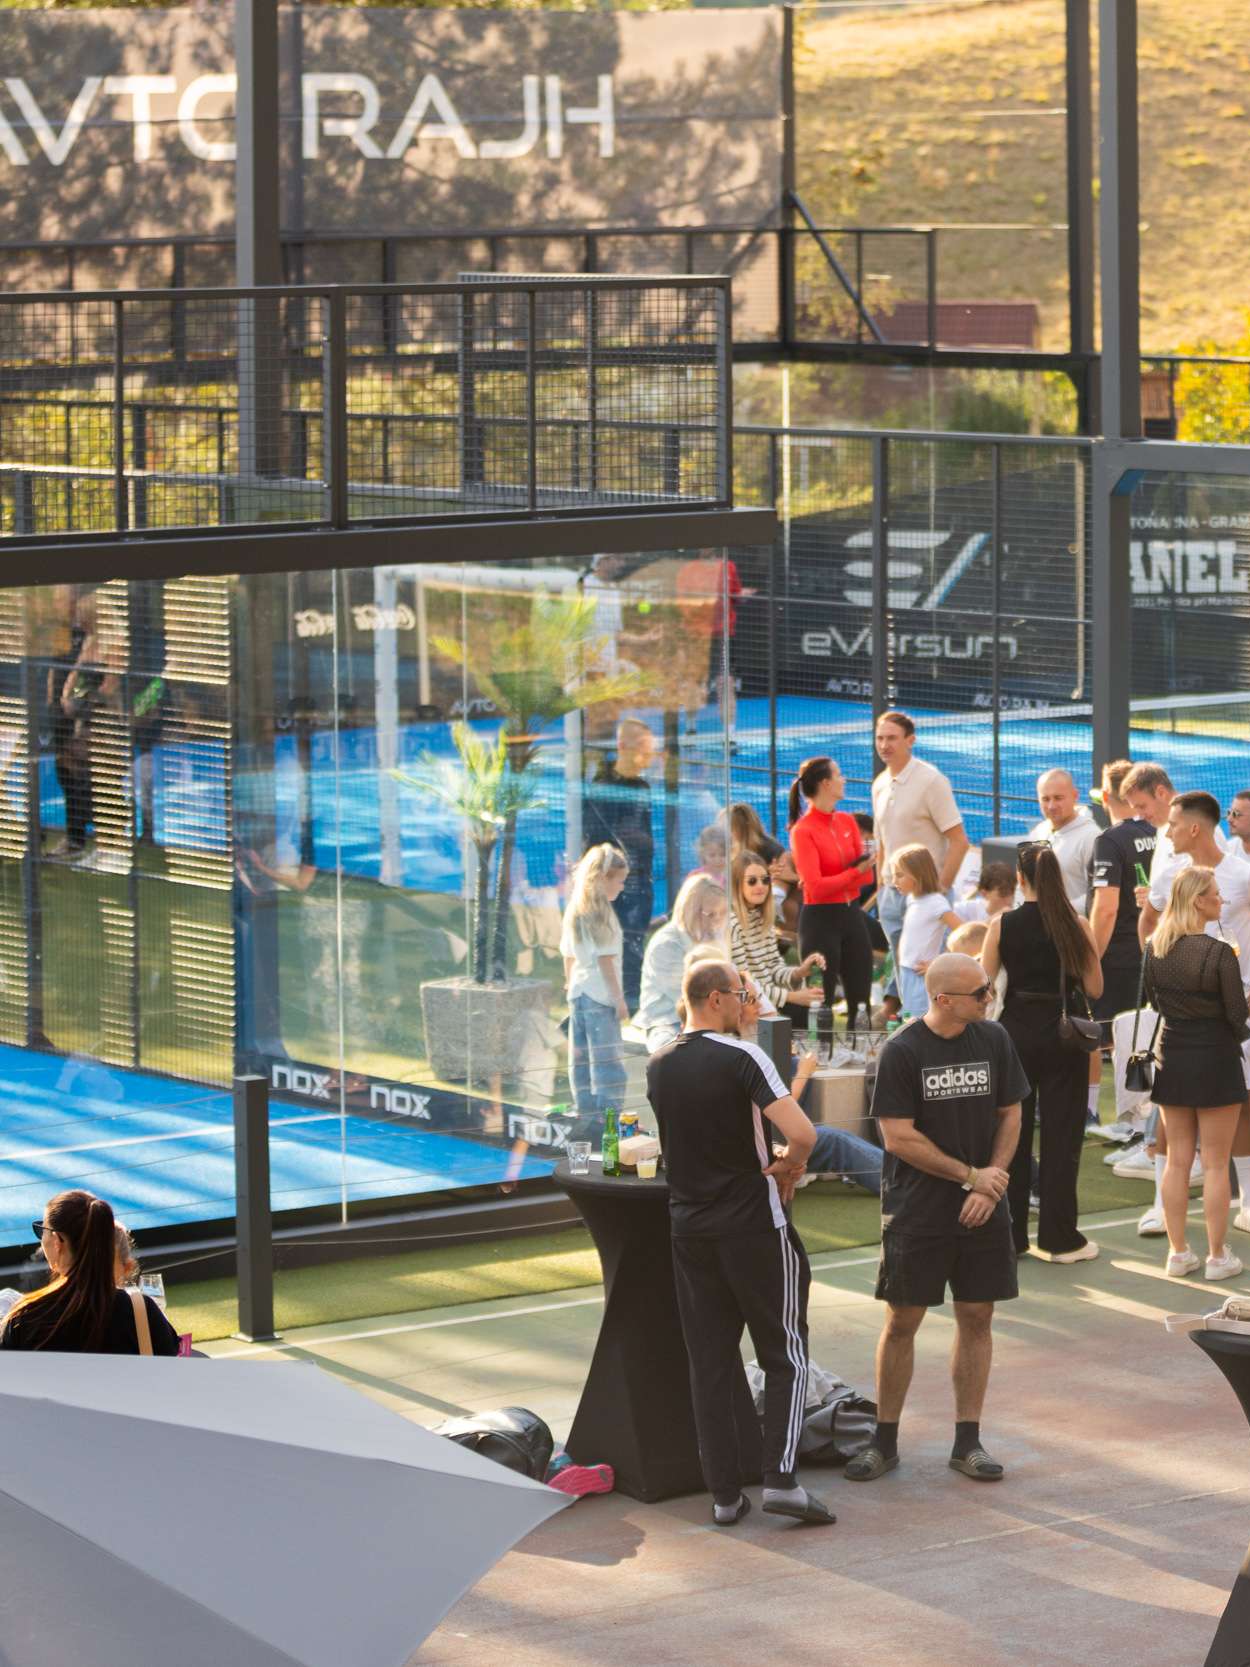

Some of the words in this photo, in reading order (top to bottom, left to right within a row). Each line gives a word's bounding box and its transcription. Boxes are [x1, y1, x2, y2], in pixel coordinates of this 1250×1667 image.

[302, 72, 615, 159] RAJH
[926, 1067, 988, 1090] adidas
[927, 1085, 988, 1097] SPORTSWEAR
